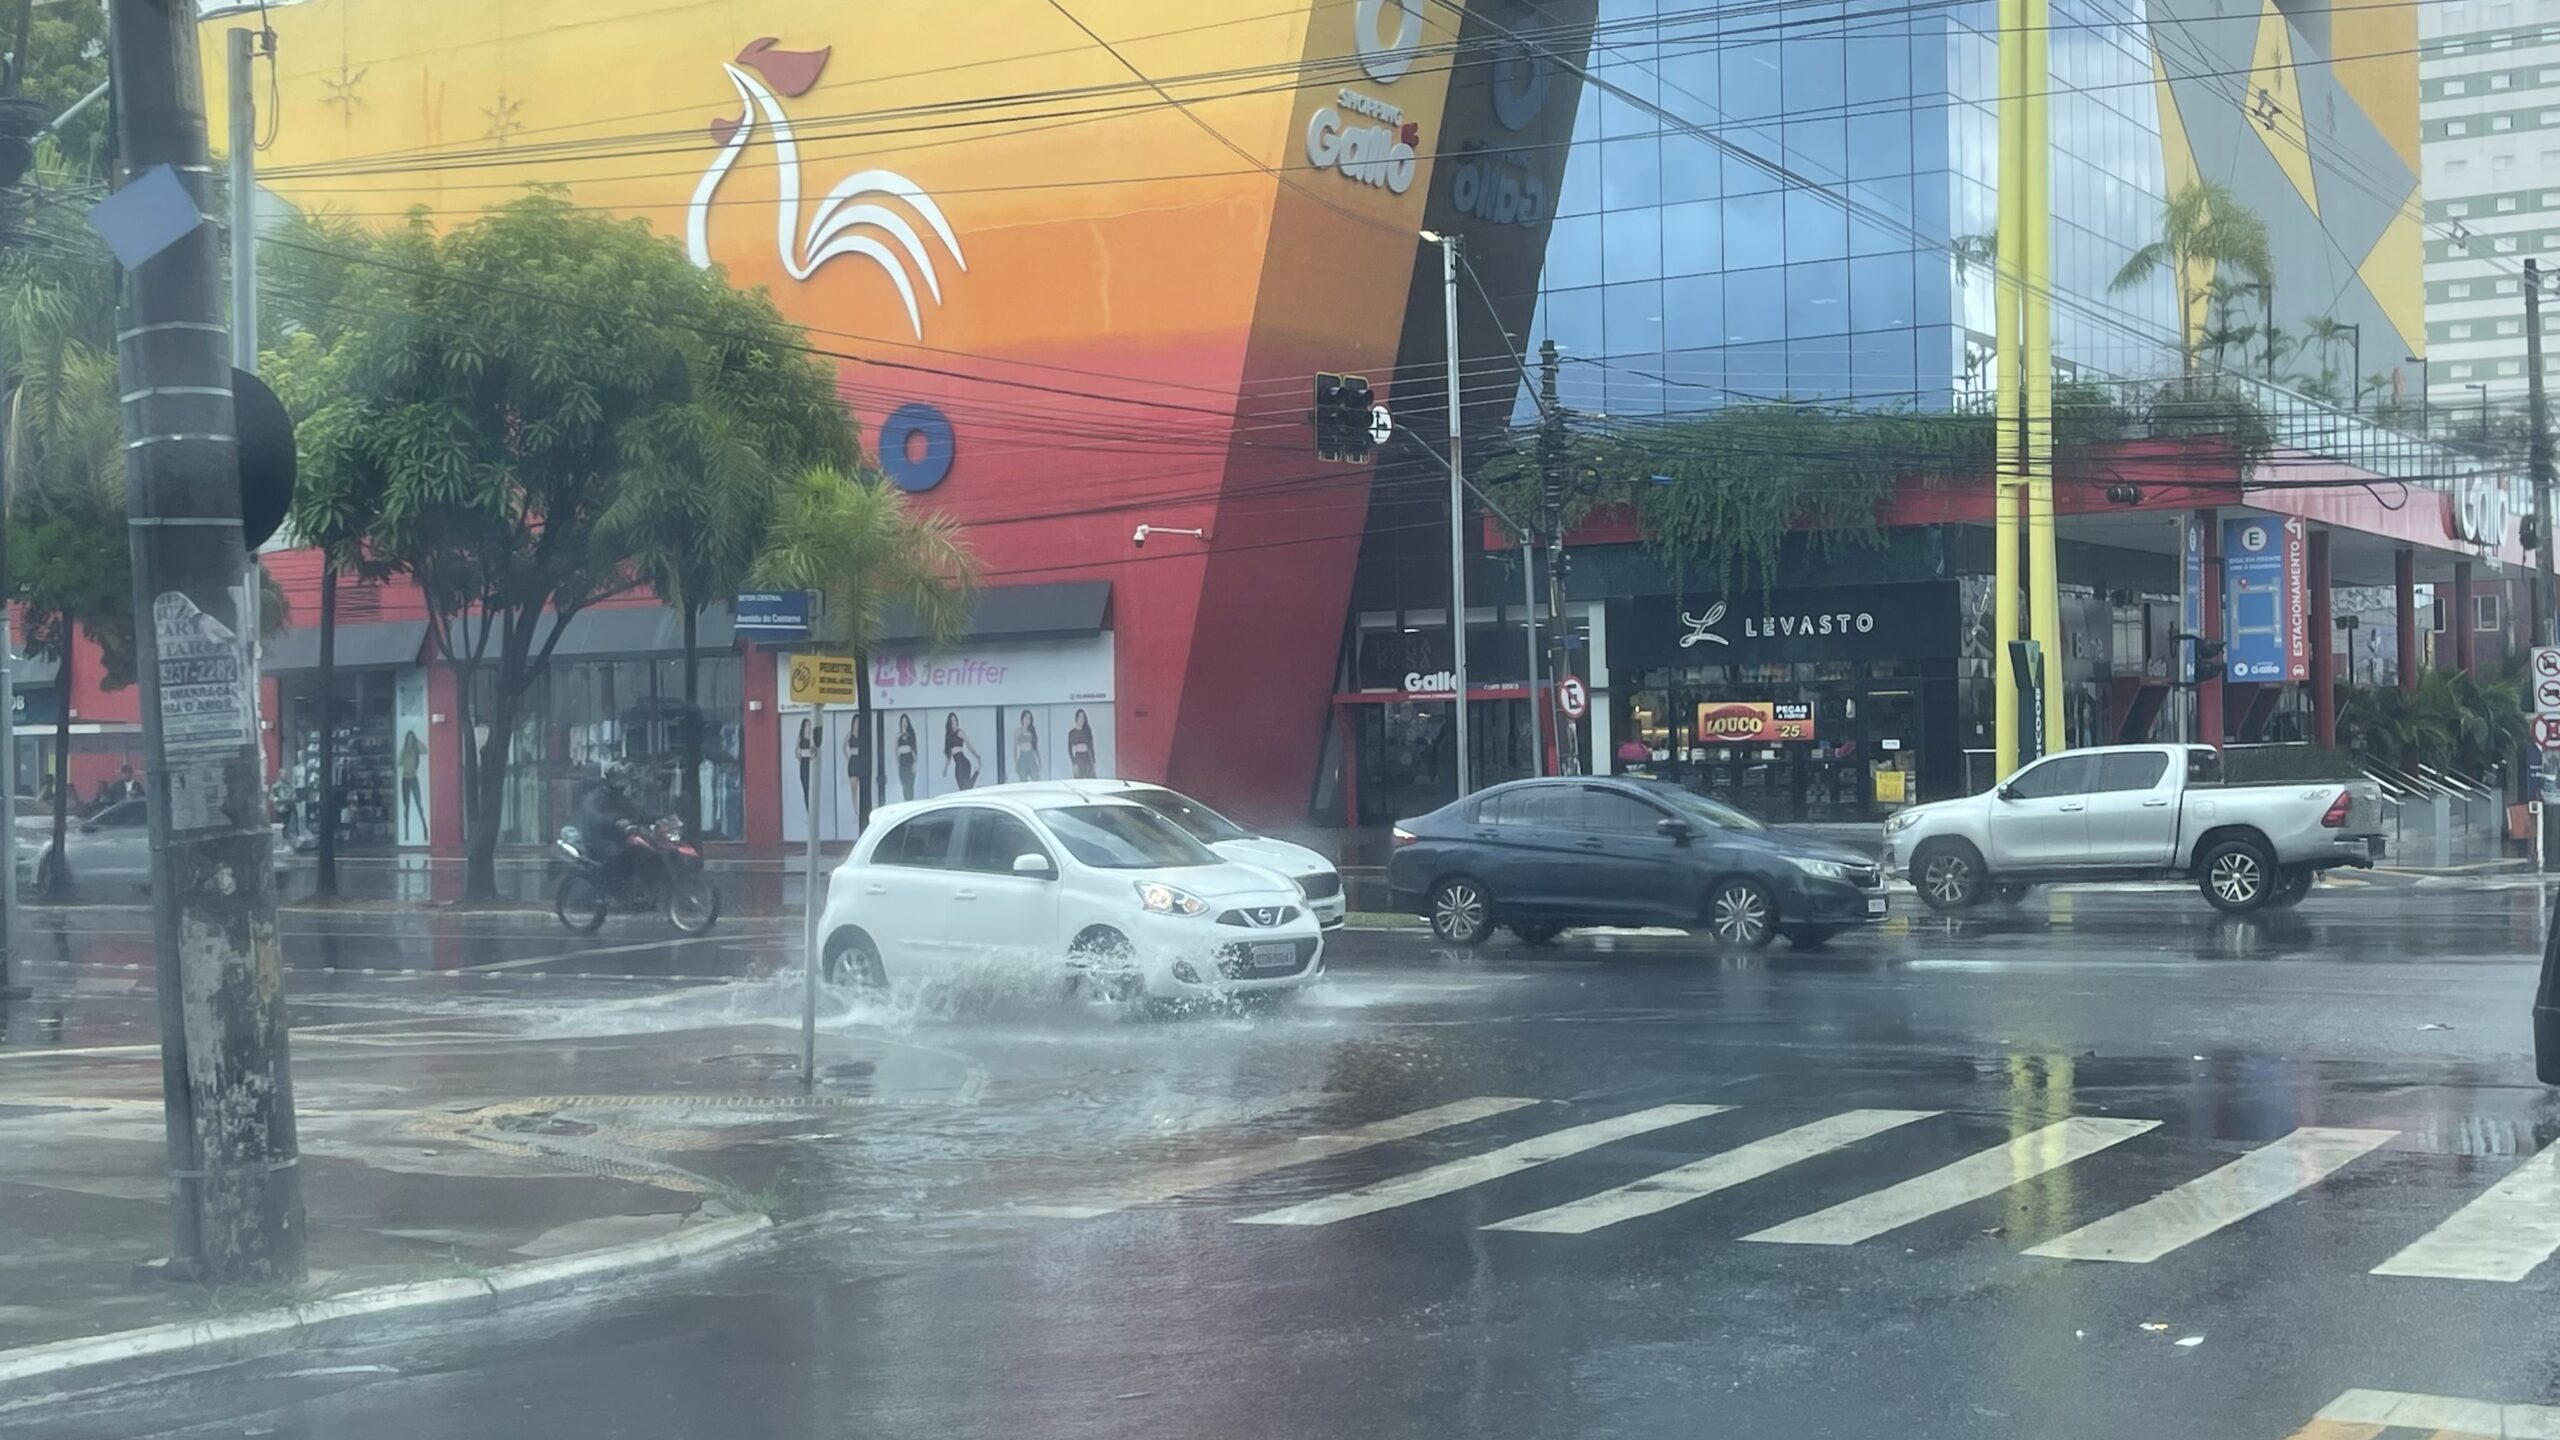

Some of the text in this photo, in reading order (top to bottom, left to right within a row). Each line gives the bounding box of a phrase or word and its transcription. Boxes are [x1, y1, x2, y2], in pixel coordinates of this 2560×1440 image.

[1336, 88, 1403, 127] SHOPPING
[1307, 107, 1416, 193] Gallo
[2248, 532, 2261, 546] E
[2290, 541, 2304, 657] ESTACIONAMENTO
[1745, 613, 1875, 638] LEVASTO
[920, 657, 1009, 687] Jeniffer
[1706, 716, 1763, 735] LOUCO
[1780, 724, 1801, 738] 25
